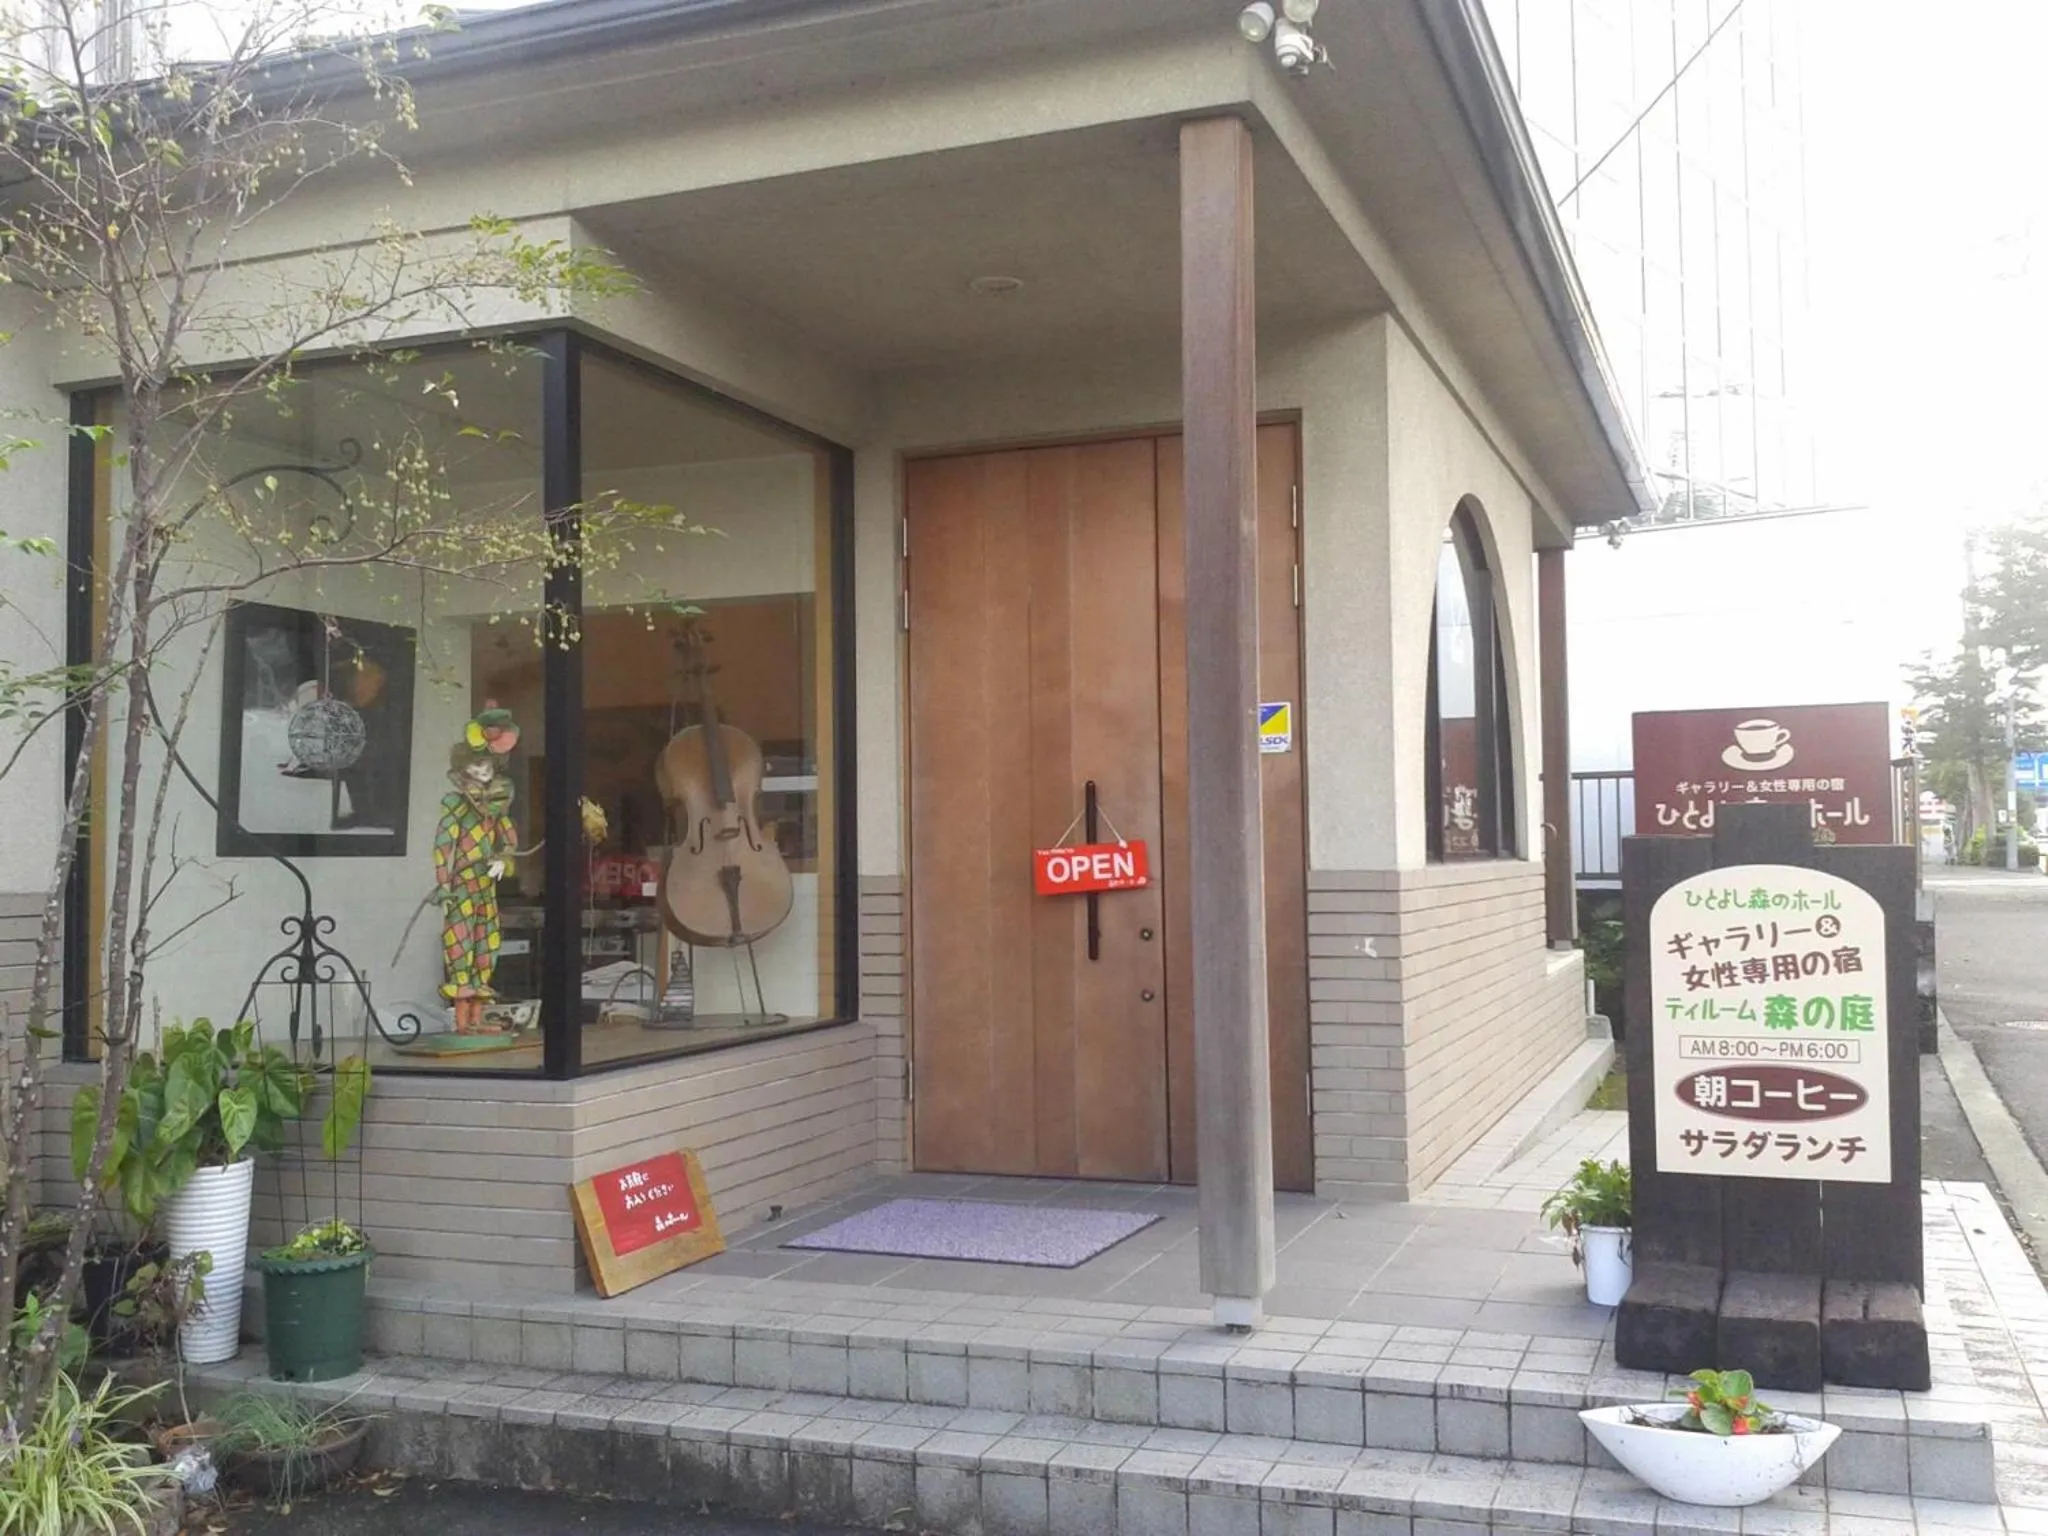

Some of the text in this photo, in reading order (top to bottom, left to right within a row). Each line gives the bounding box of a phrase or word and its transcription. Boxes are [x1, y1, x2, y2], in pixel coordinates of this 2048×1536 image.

[1655, 797, 1871, 830] ひとよホール
[1046, 851, 1135, 883] OPEN
[1684, 887, 1842, 911] ひとよし森のホール
[1667, 914, 1842, 960] ギャラリー&
[1681, 945, 1864, 992] 女性専用の宿
[1763, 994, 1876, 1031] 森の庭
[1693, 1074, 1859, 1111] 朝コーヒー
[1679, 1129, 1867, 1164] サラダランチ
